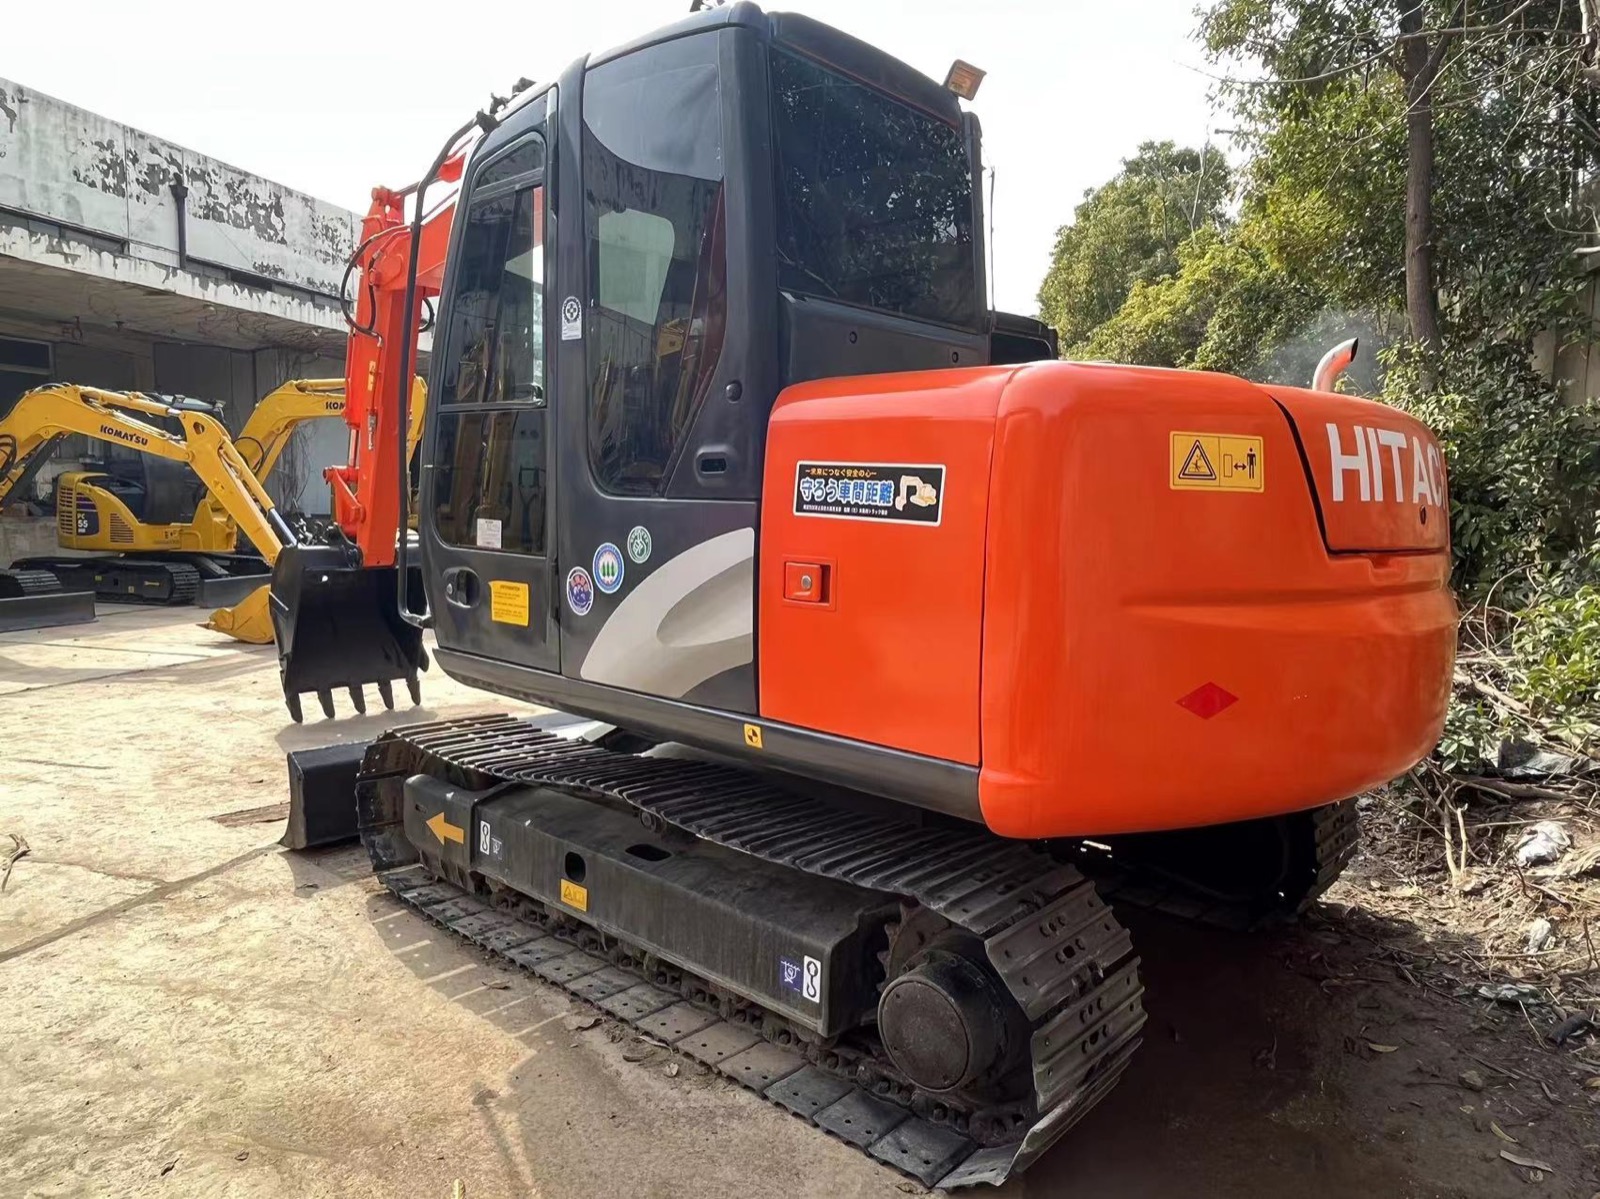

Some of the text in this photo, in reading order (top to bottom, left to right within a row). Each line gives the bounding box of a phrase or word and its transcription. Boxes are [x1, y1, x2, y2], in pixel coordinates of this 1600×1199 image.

[100, 424, 149, 446] KOMATSU
[1325, 423, 1446, 509] HITAC
[800, 477, 894, 506] 守ろう車間距離
[77, 512, 86, 520] PC
